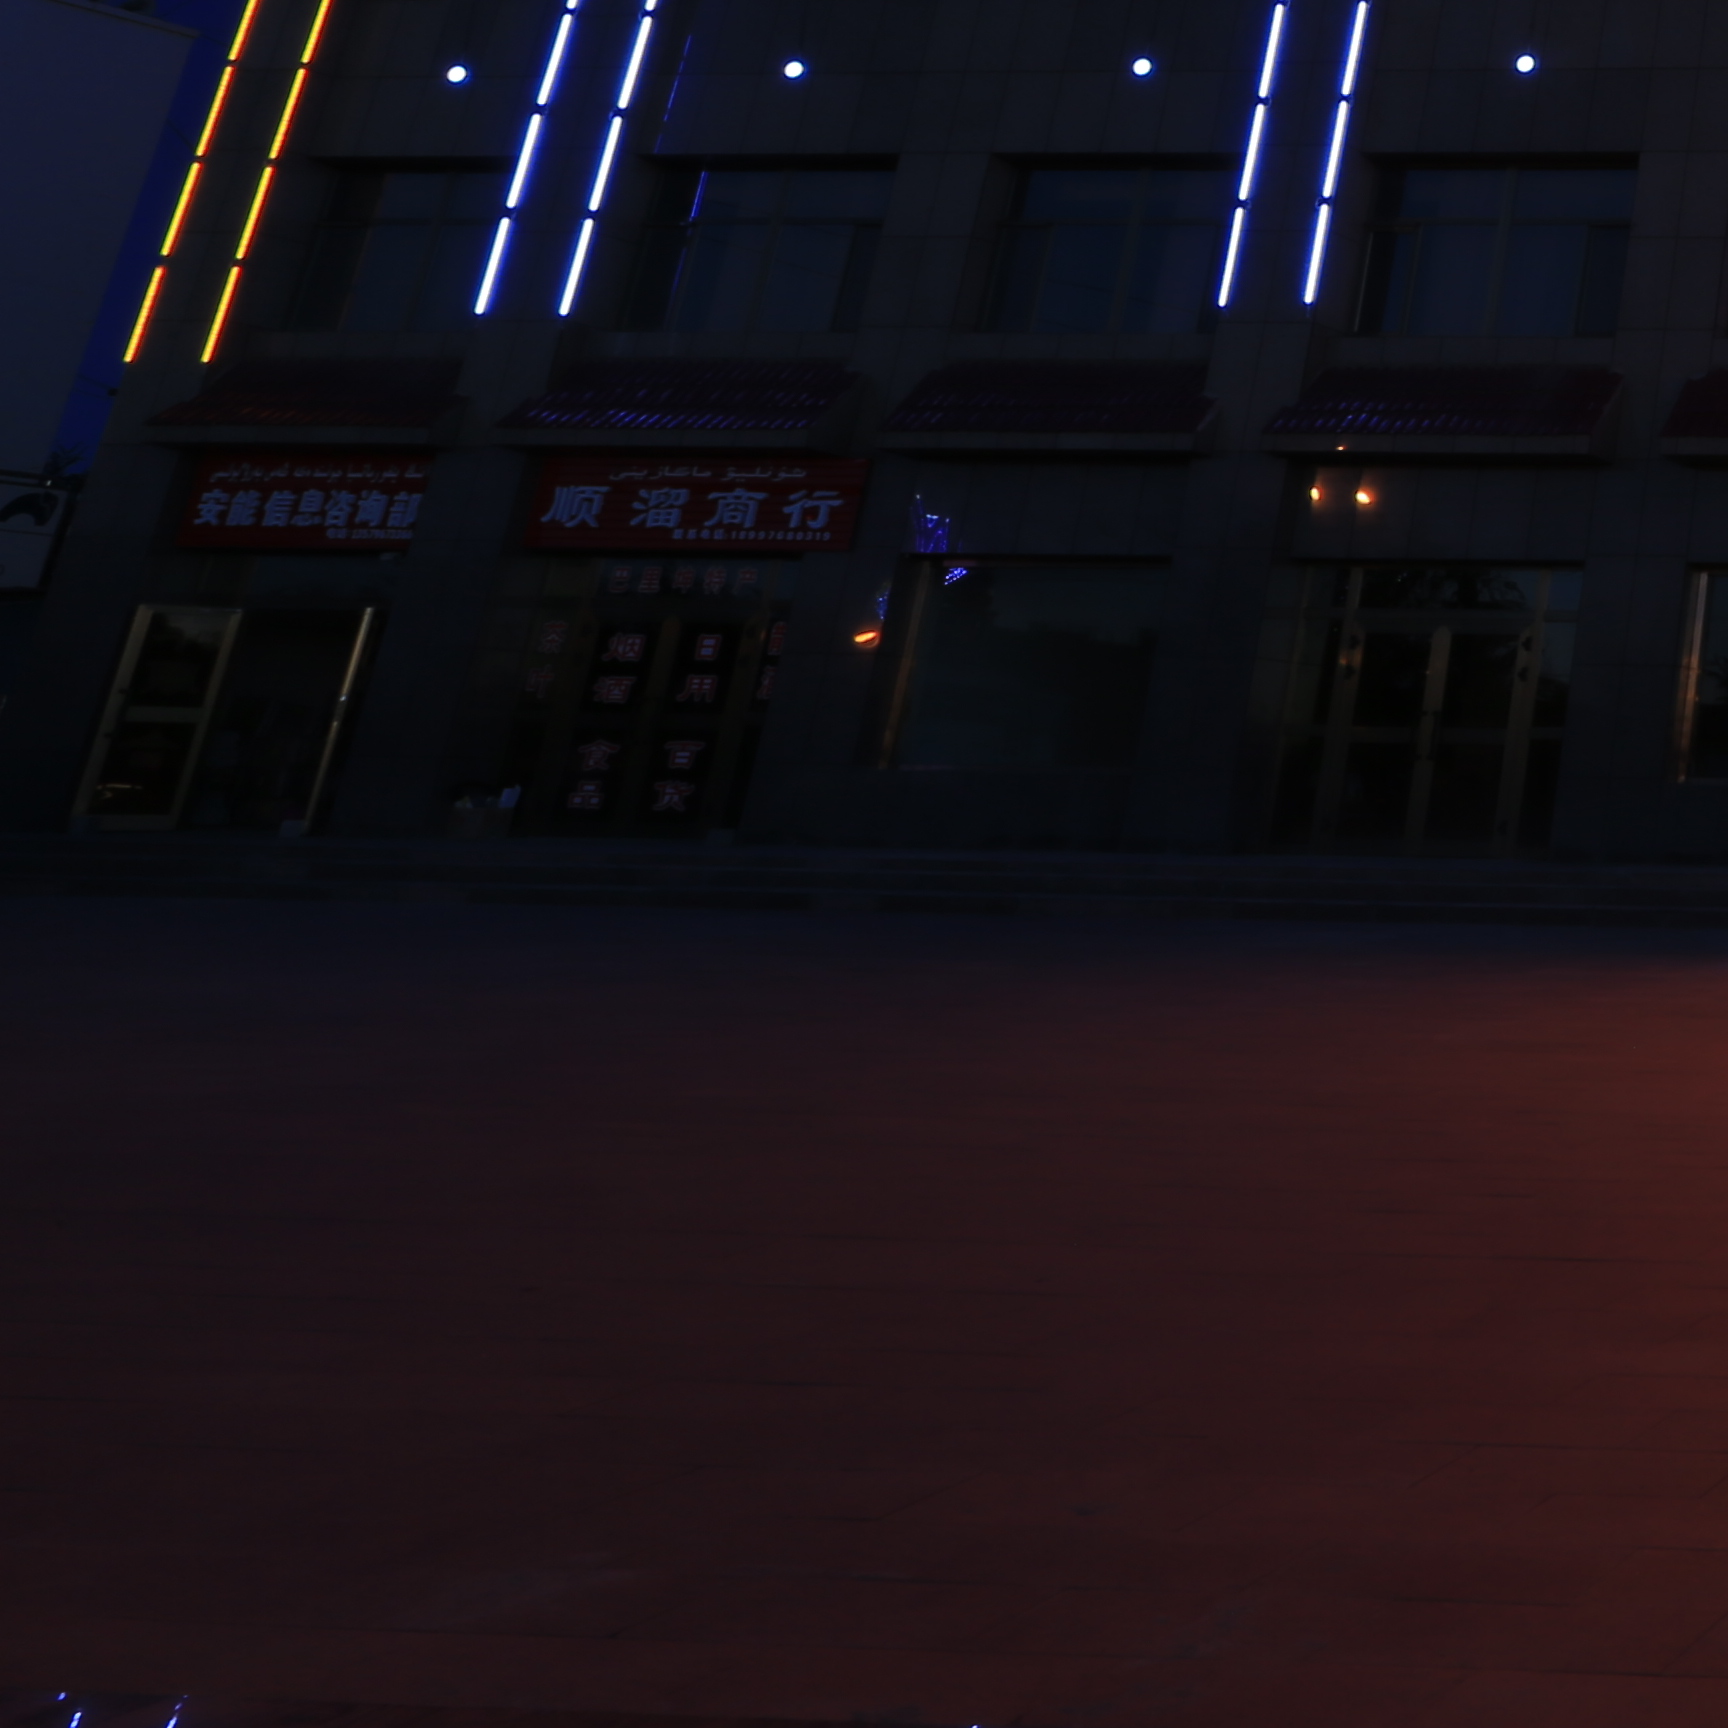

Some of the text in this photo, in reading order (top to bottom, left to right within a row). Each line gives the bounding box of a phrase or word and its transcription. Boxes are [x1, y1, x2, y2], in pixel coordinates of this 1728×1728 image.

[193, 488, 424, 528] 安能信息咨询部
[540, 485, 846, 530] 顺溜商行
[608, 565, 758, 595] 巴里坤特产
[524, 619, 569, 699] 茶叶
[592, 631, 648, 705] 烟酒
[566, 737, 622, 811] 食品
